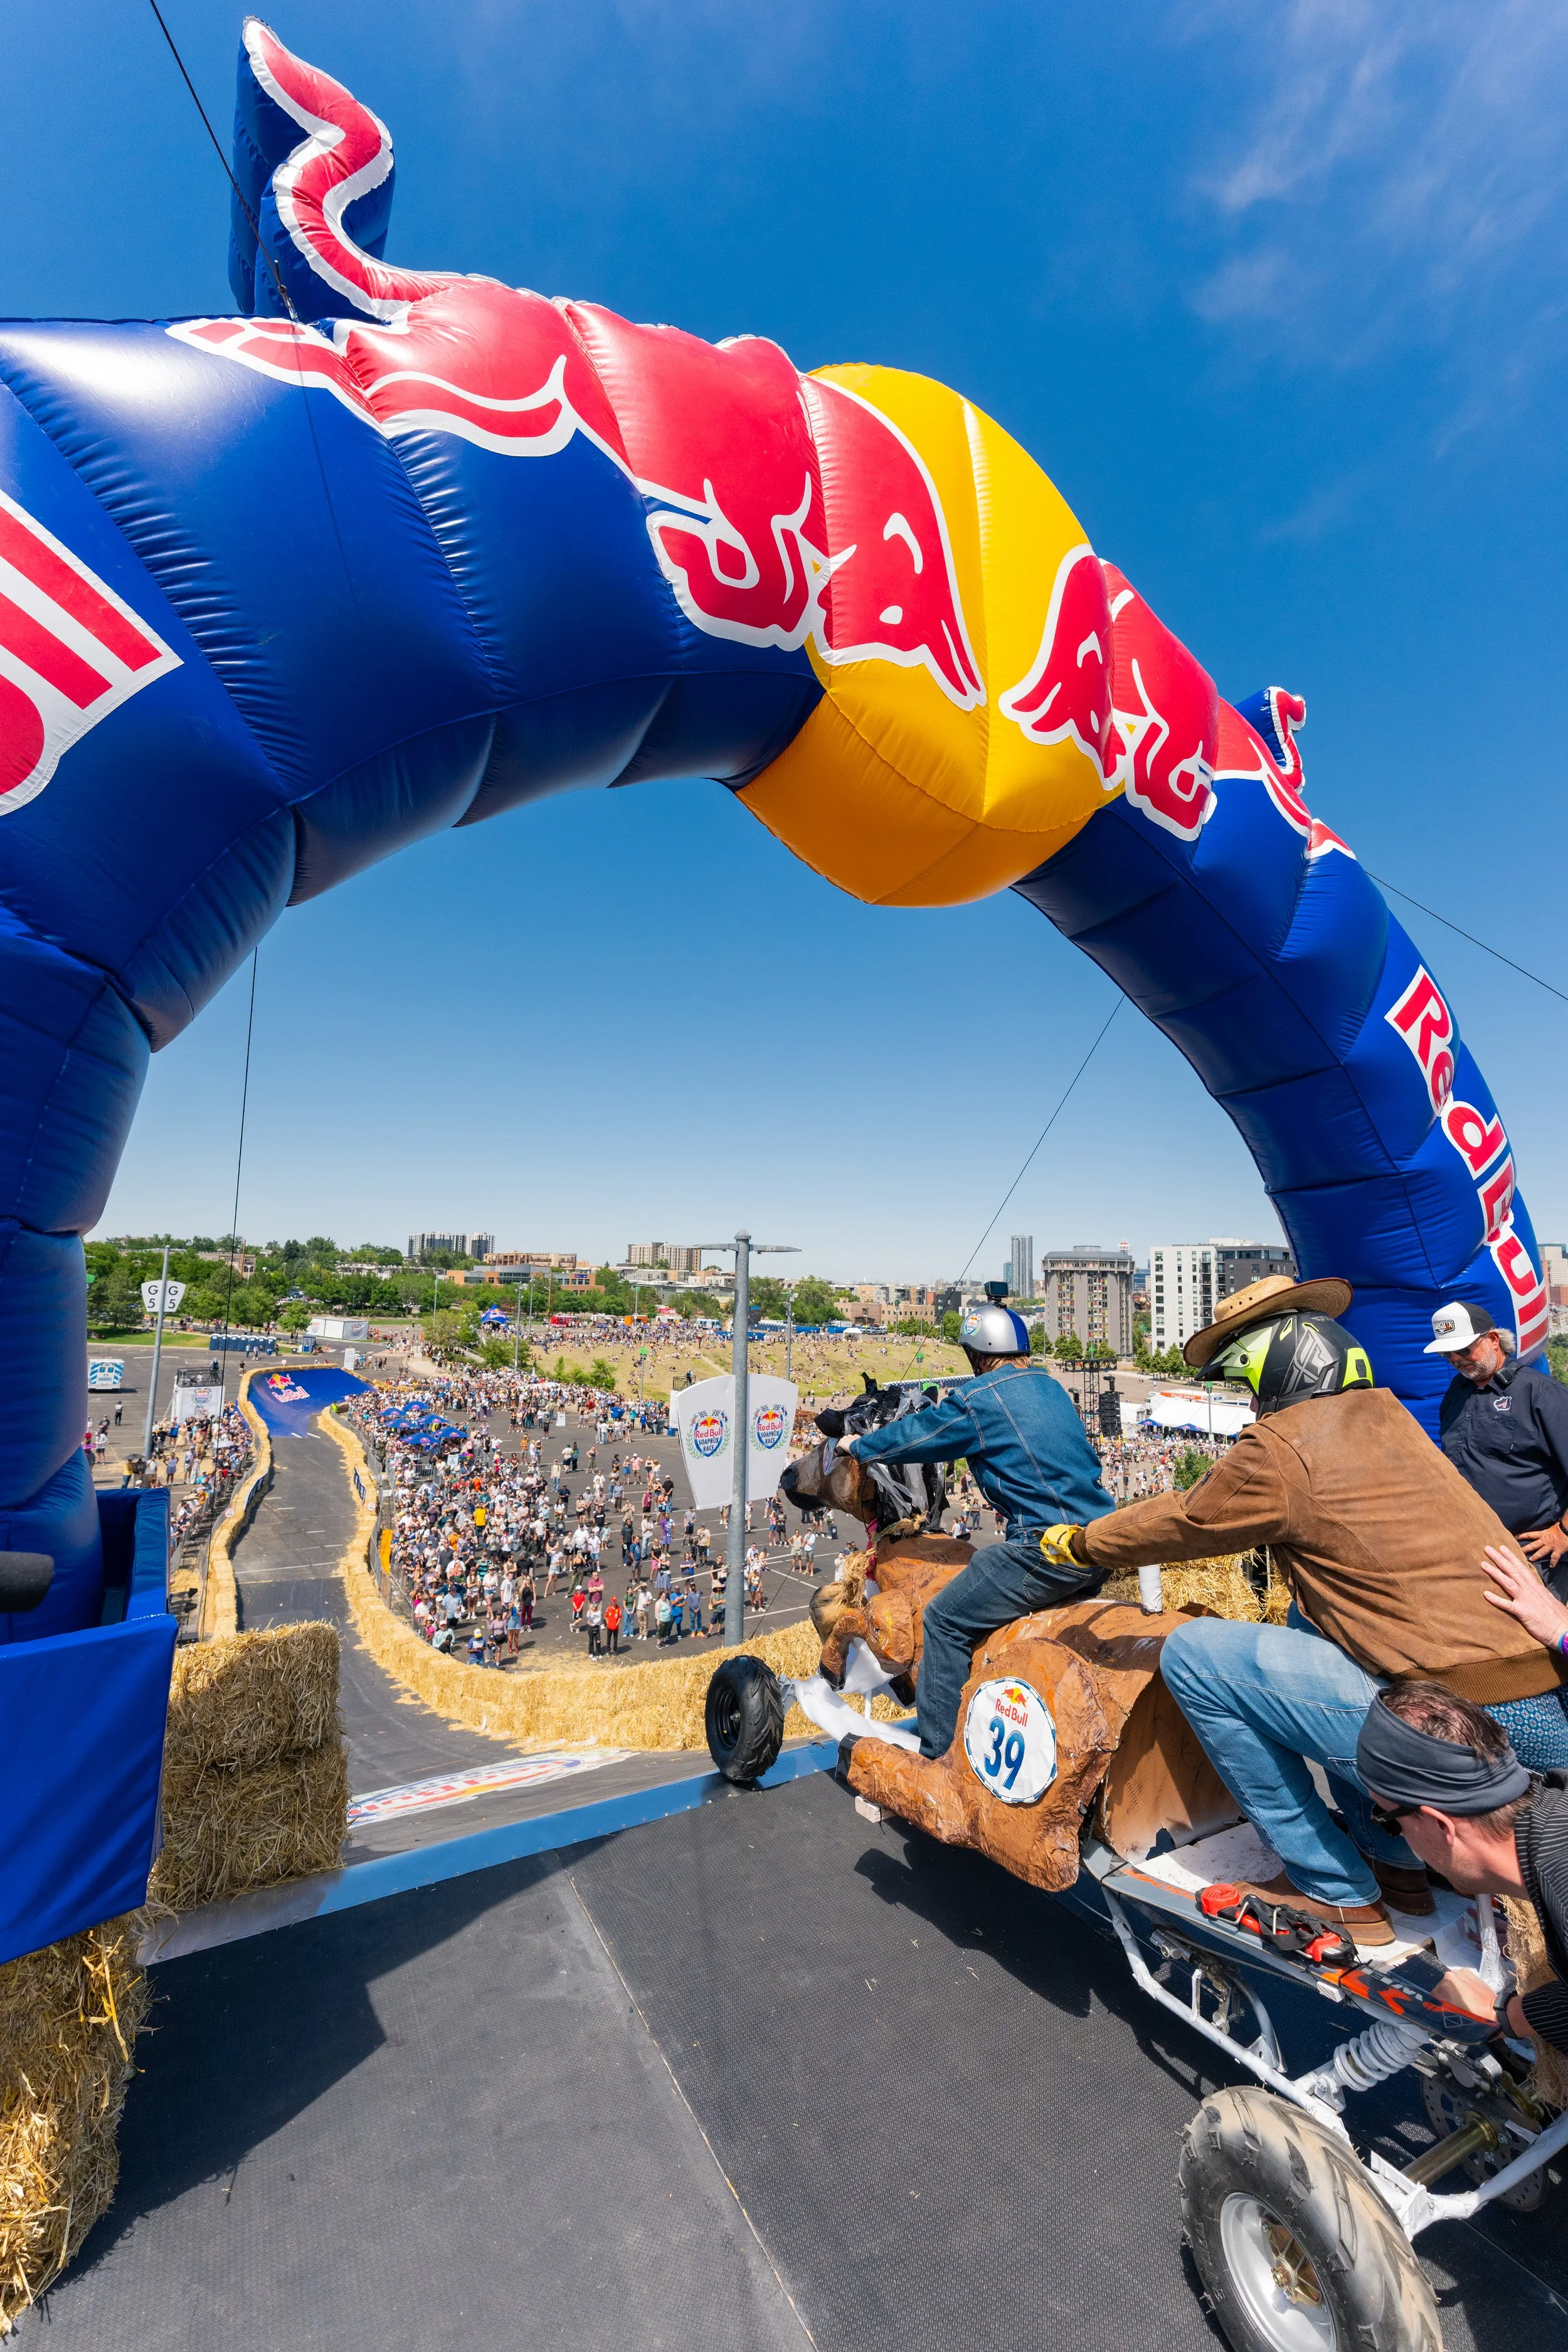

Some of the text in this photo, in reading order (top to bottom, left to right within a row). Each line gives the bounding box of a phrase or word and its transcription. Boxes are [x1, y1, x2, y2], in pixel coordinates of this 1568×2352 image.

[1393, 973, 1549, 1353] Red Bull
[148, 1285, 159, 1295] G
[168, 1286, 178, 1296] G
[147, 1298, 156, 1308] 5
[168, 1299, 176, 1309] 5
[285, 1386, 310, 1399] Bull
[758, 1421, 783, 1431] Red Bull
[695, 1427, 723, 1439] Red Bull
[761, 1429, 780, 1438] SOAPBOX
[699, 1436, 719, 1446] SOAPBOX
[996, 1698, 1029, 1727] Red Bull
[984, 1716, 1025, 1790] 39
